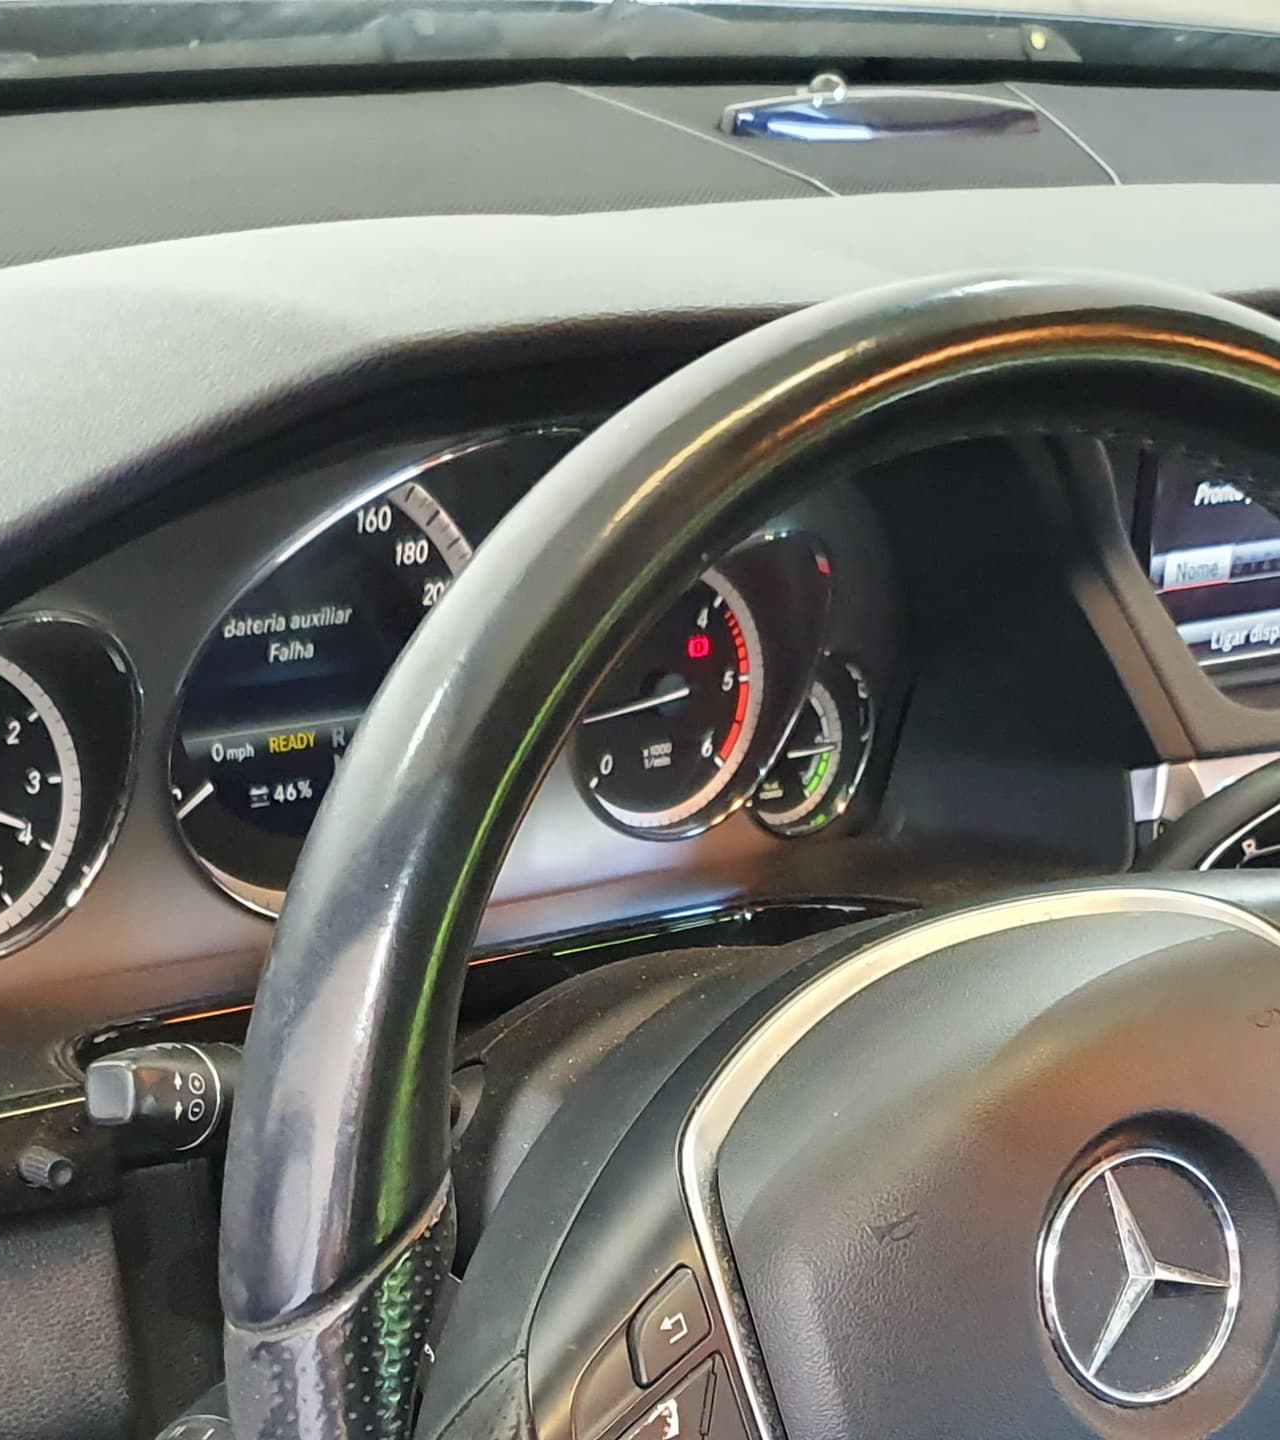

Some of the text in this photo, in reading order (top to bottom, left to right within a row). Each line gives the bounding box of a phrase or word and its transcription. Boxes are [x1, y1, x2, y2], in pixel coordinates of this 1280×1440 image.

[357, 506, 392, 534] 160
[395, 540, 429, 566] 180
[1175, 563, 1219, 583] Nome
[422, 580, 451, 606] 20
[289, 605, 353, 631] auxiliar
[696, 607, 709, 629] 4
[268, 642, 314, 664] Falha
[1210, 630, 1247, 652] Ligar
[722, 670, 735, 692] 5
[6, 720, 21, 745] 2
[212, 732, 317, 763] 0 mph READY
[701, 735, 713, 758] 6
[600, 753, 613, 775] 0
[25, 770, 41, 795] 3
[273, 779, 313, 804] 46%
[17, 822, 33, 846] 4
